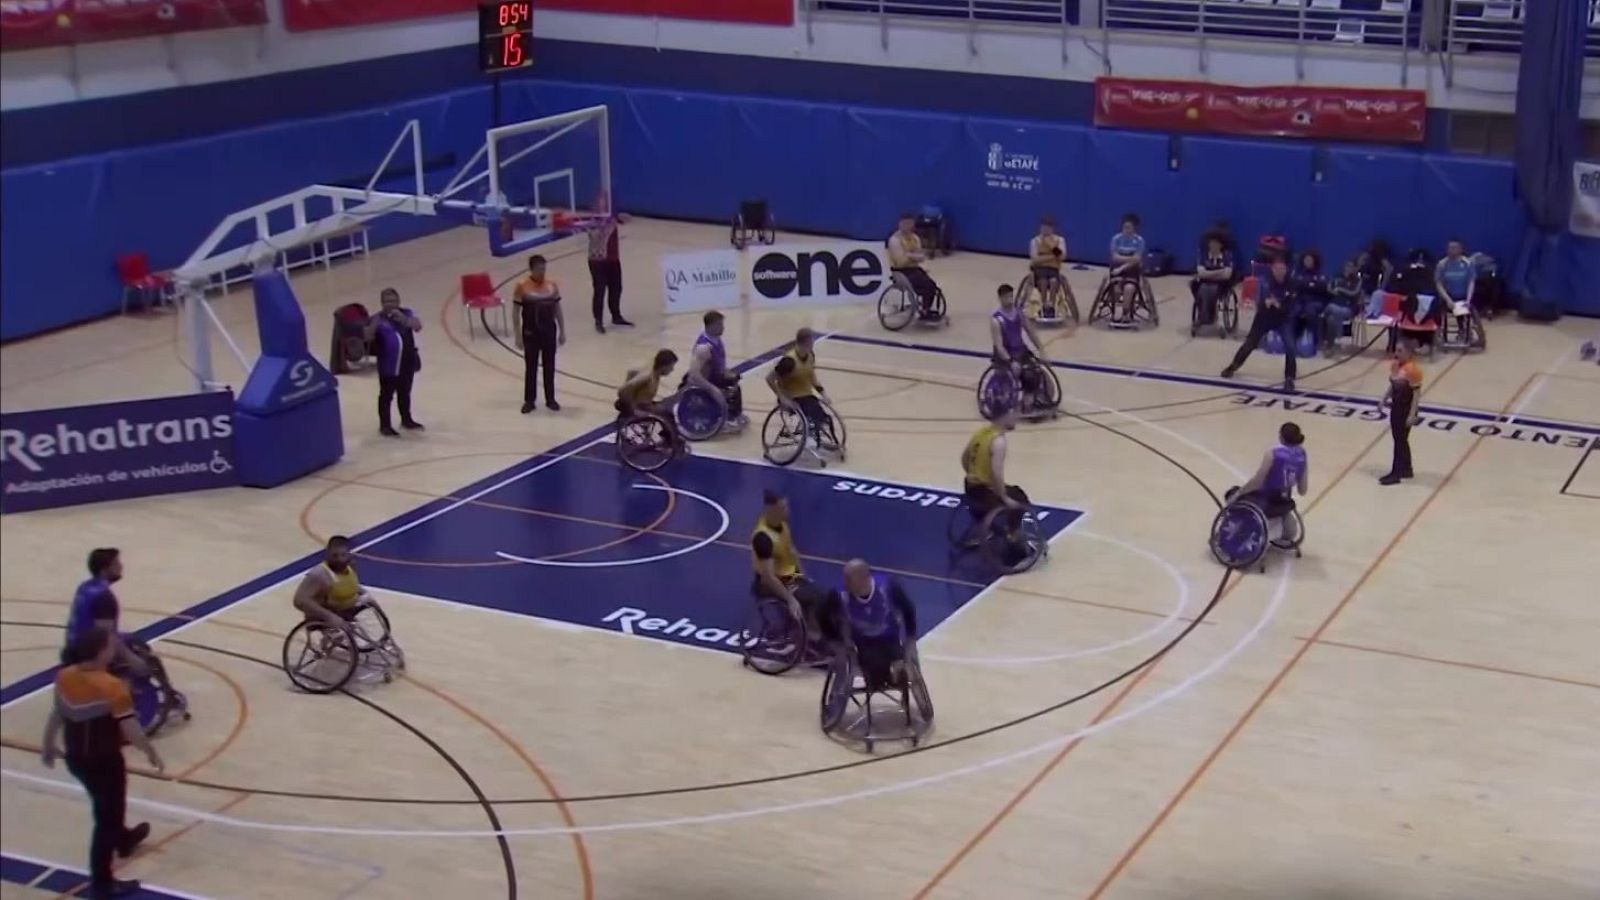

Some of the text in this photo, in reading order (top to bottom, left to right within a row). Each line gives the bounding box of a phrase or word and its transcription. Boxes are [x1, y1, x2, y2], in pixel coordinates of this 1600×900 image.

[503, 33, 522, 66] 15
[753, 269, 797, 281] software
[1229, 393, 1389, 421] GETAFE
[0, 414, 233, 472] Rehatrans
[5, 460, 209, 494] Adaptación de vehículos
